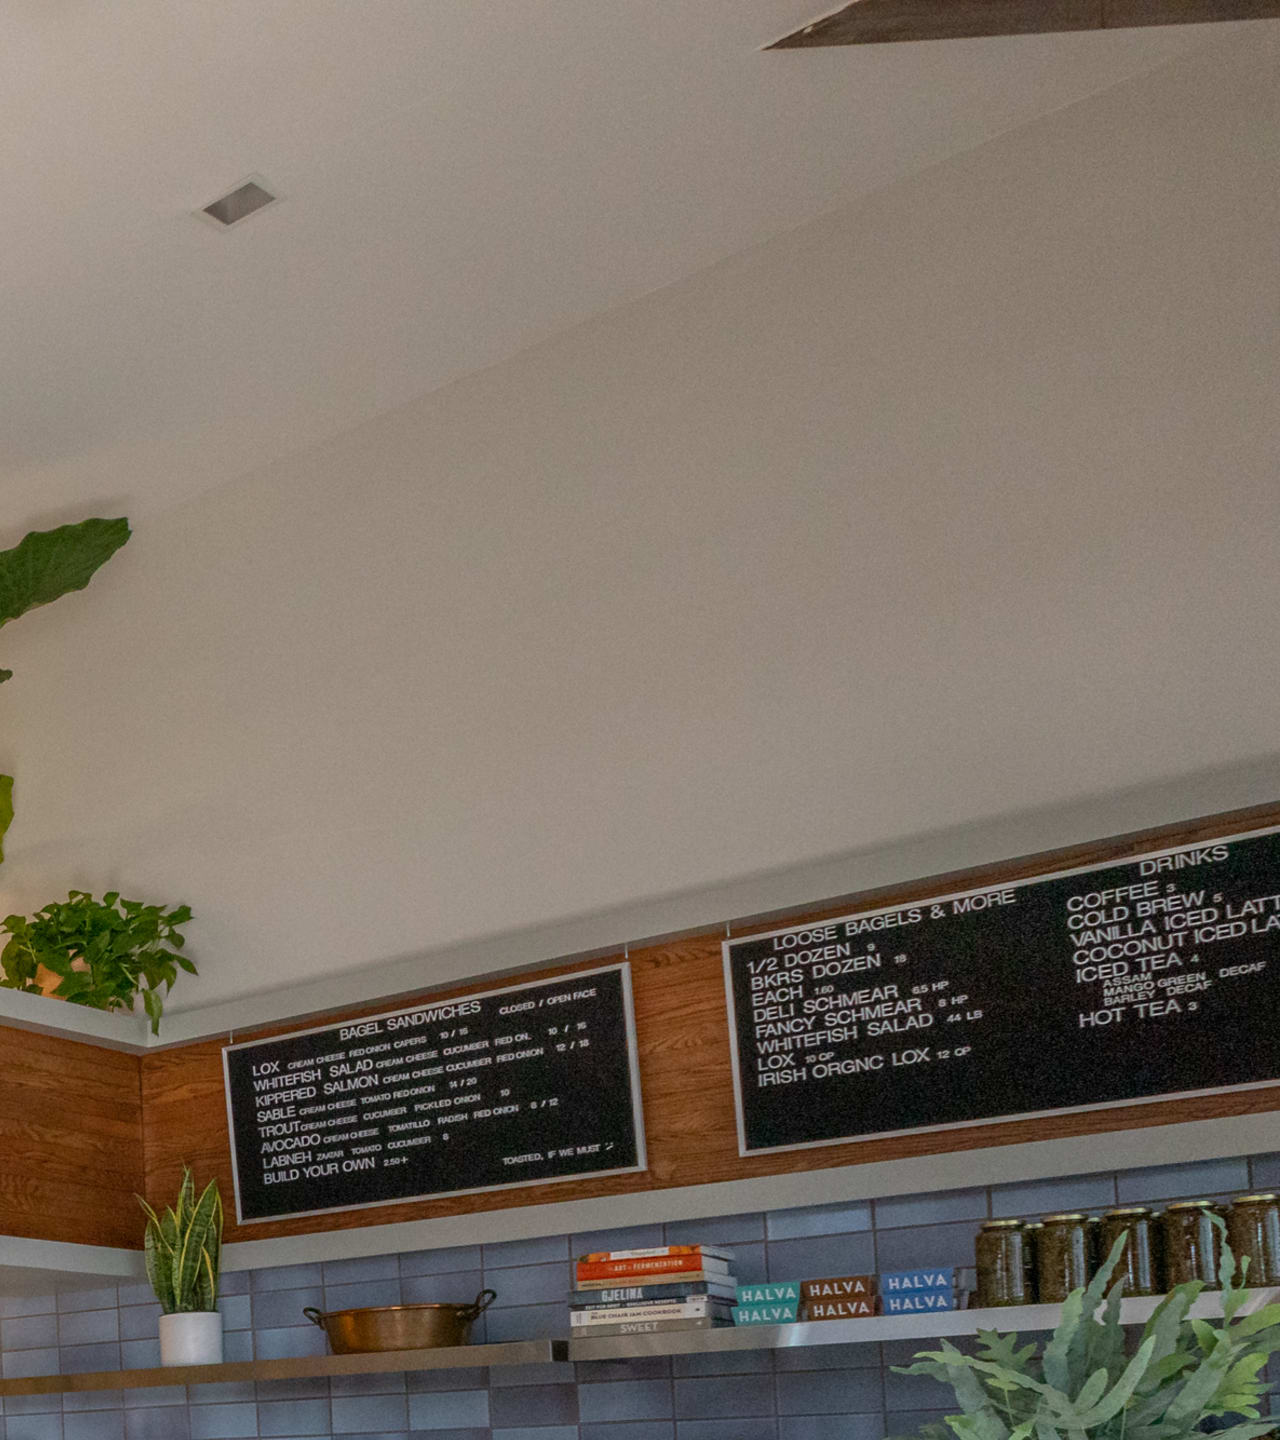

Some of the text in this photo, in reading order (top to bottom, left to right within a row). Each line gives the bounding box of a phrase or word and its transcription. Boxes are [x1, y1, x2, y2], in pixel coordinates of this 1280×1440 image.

[1140, 845, 1229, 876] DRINKS
[1067, 880, 1177, 912] COFFEE 3
[1067, 889, 1224, 930] COLD BREW 5
[773, 889, 1017, 951] LOOSE BAGELS & MORE
[1069, 919, 1157, 947] VANILLA
[1164, 907, 1219, 931] ICED
[746, 942, 851, 974] 1/2 DOZEN
[1073, 921, 1247, 965] COCONUT ICED
[751, 953, 881, 991] BKRS DOZEN
[1076, 952, 1183, 984] ICED TEA
[1103, 960, 1268, 997] MANGO GREEN DECAF
[1103, 972, 1153, 988] ASSAM
[499, 988, 597, 1015] CLOSED OPEN FACE
[752, 985, 803, 1007] EACH
[753, 984, 898, 1023] DELI SCHMEAR
[1103, 980, 1213, 1007] BARLEY DECAF
[340, 1000, 481, 1041] BAGEL SANDWICHES
[755, 997, 922, 1039] FANCY SCHMEAR
[1079, 998, 1182, 1028] HOT TEA
[757, 1013, 933, 1054] WHITEFISH SALAD
[252, 1035, 428, 1076] LOX CAPERS
[253, 1040, 490, 1092] WHITEFISH SALAD CREAM CHEESE CUCUMBER
[757, 1052, 796, 1071] LOX
[757, 1047, 931, 1087] IRISH ORGNC LOX
[255, 1057, 492, 1108] KIPPERED SALMON CREAM CHEESE CUCUMBER
[256, 1104, 326, 1123] SABLE CREAM
[257, 1099, 452, 1139] TROUT PICKLED
[260, 1133, 320, 1154] AVOCADO
[262, 1150, 312, 1169] LABNEH
[263, 1156, 376, 1185] BUILD YOUR OWN
[601, 1287, 644, 1302] GJELINA
[741, 1287, 796, 1302] HALVA
[809, 1281, 865, 1296] HALVA
[888, 1274, 947, 1290] HALVA
[739, 1306, 793, 1322] HALVA
[813, 1301, 870, 1317] HALVA
[890, 1296, 948, 1311] HALVA
[620, 1322, 659, 1333] SWEET
